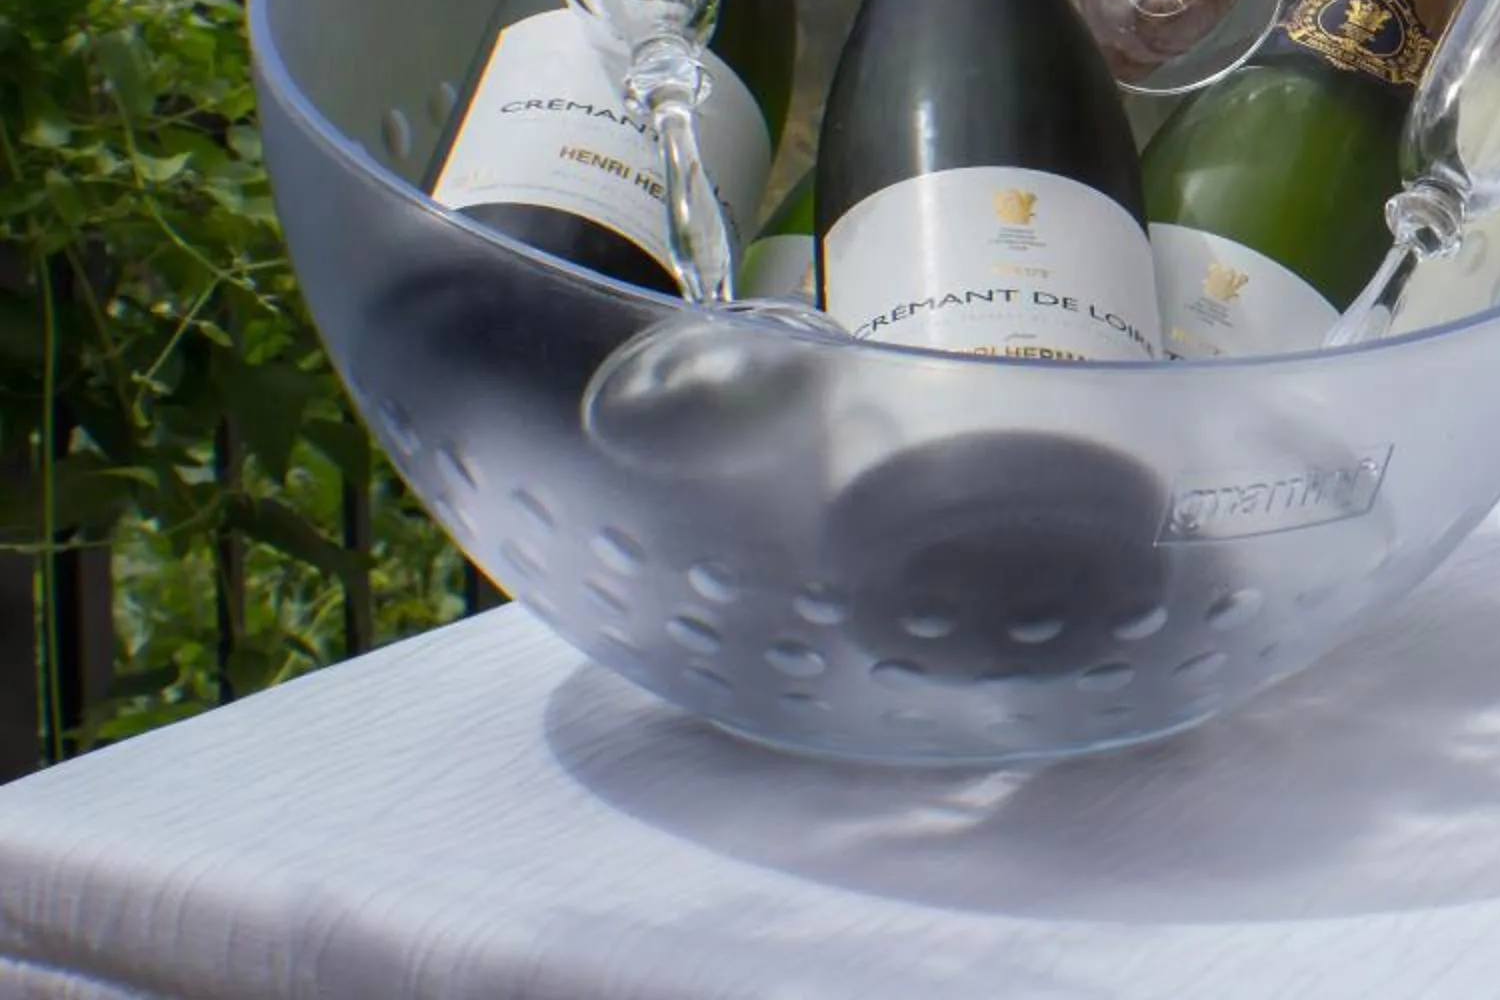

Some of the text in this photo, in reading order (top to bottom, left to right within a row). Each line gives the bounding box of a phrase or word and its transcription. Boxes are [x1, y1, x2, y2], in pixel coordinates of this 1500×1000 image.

[559, 145, 669, 204] HENRI HE
[1033, 290, 1081, 312] DE
